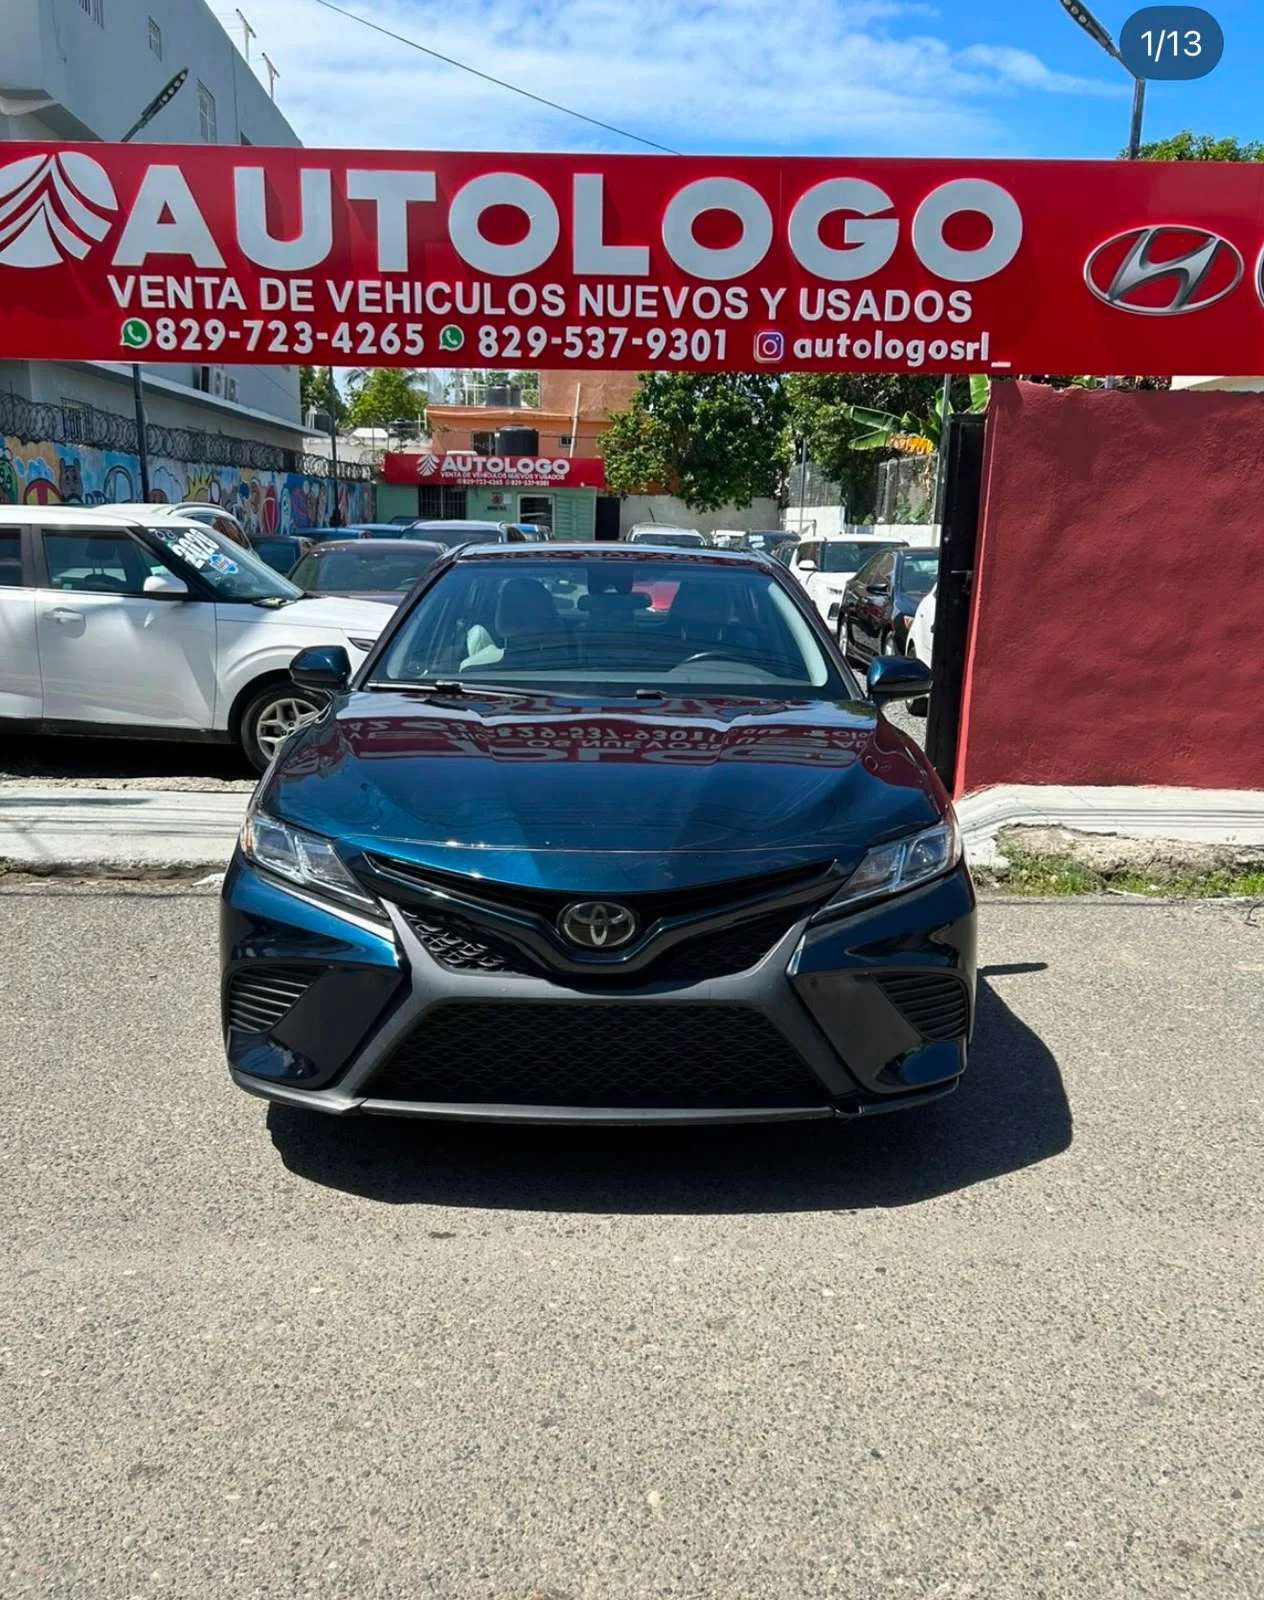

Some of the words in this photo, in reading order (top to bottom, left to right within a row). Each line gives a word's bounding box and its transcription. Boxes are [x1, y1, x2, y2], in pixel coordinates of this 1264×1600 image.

[111, 164, 1023, 283] AUTOLOGO
[107, 274, 247, 311] VENTA
[260, 277, 315, 312] DE
[326, 280, 566, 318] VEHICULOS
[579, 284, 749, 321] NUEVOS
[760, 287, 787, 320] Y
[799, 288, 973, 324] USADOS
[155, 317, 425, 355] 829-723-4265
[478, 325, 727, 361] 829-537-9301
[792, 331, 1012, 368] autologosrl_
[441, 456, 570, 474] AUTOLOGO
